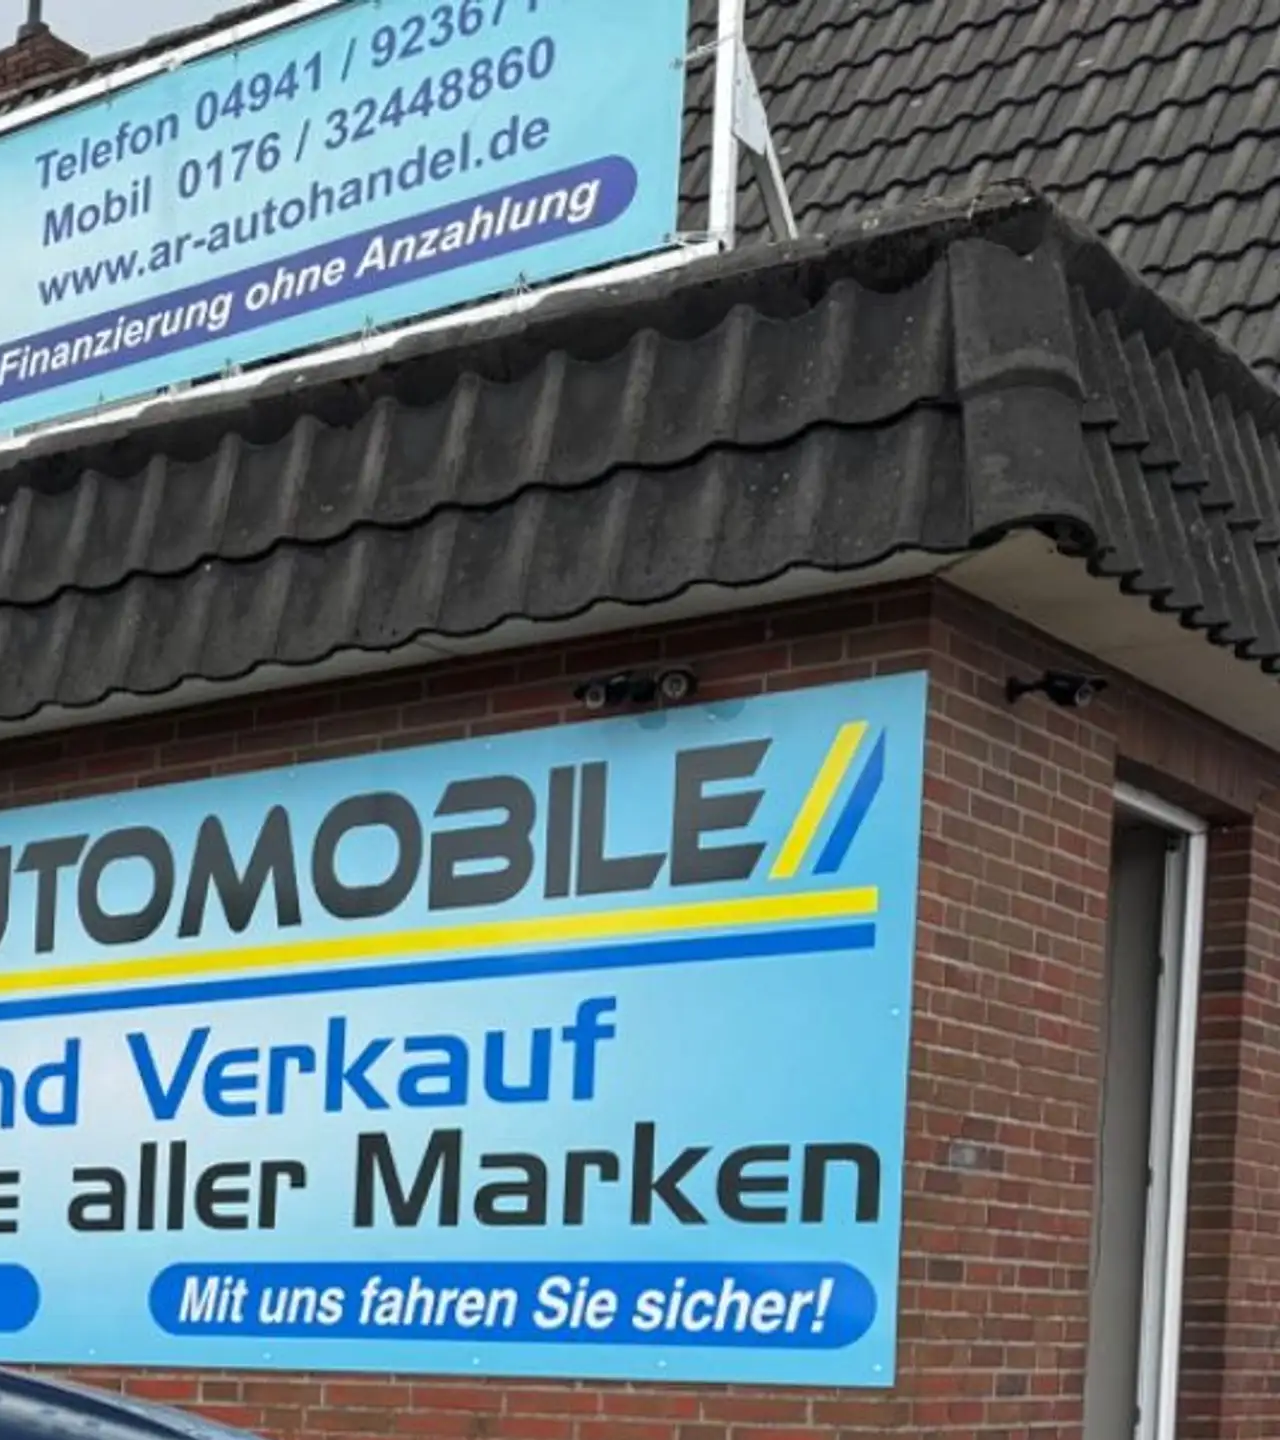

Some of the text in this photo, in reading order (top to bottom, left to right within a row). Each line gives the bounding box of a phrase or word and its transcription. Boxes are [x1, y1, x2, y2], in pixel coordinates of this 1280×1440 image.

[35, 110, 180, 191] Telefon
[195, 54, 324, 132] 04941
[41, 183, 152, 246] Mobil
[178, 131, 281, 201] 0176
[324, 36, 555, 152] 32448860
[37, 112, 550, 307] www.ar-autohandel.de
[244, 255, 346, 311] ohne
[355, 174, 601, 279] Anzahlung
[127, 996, 616, 1119] Verkauf
[68, 1139, 306, 1231] aller
[353, 1121, 881, 1227] Marken
[178, 1275, 834, 1332] Mit uns fahren Sie sicher!
